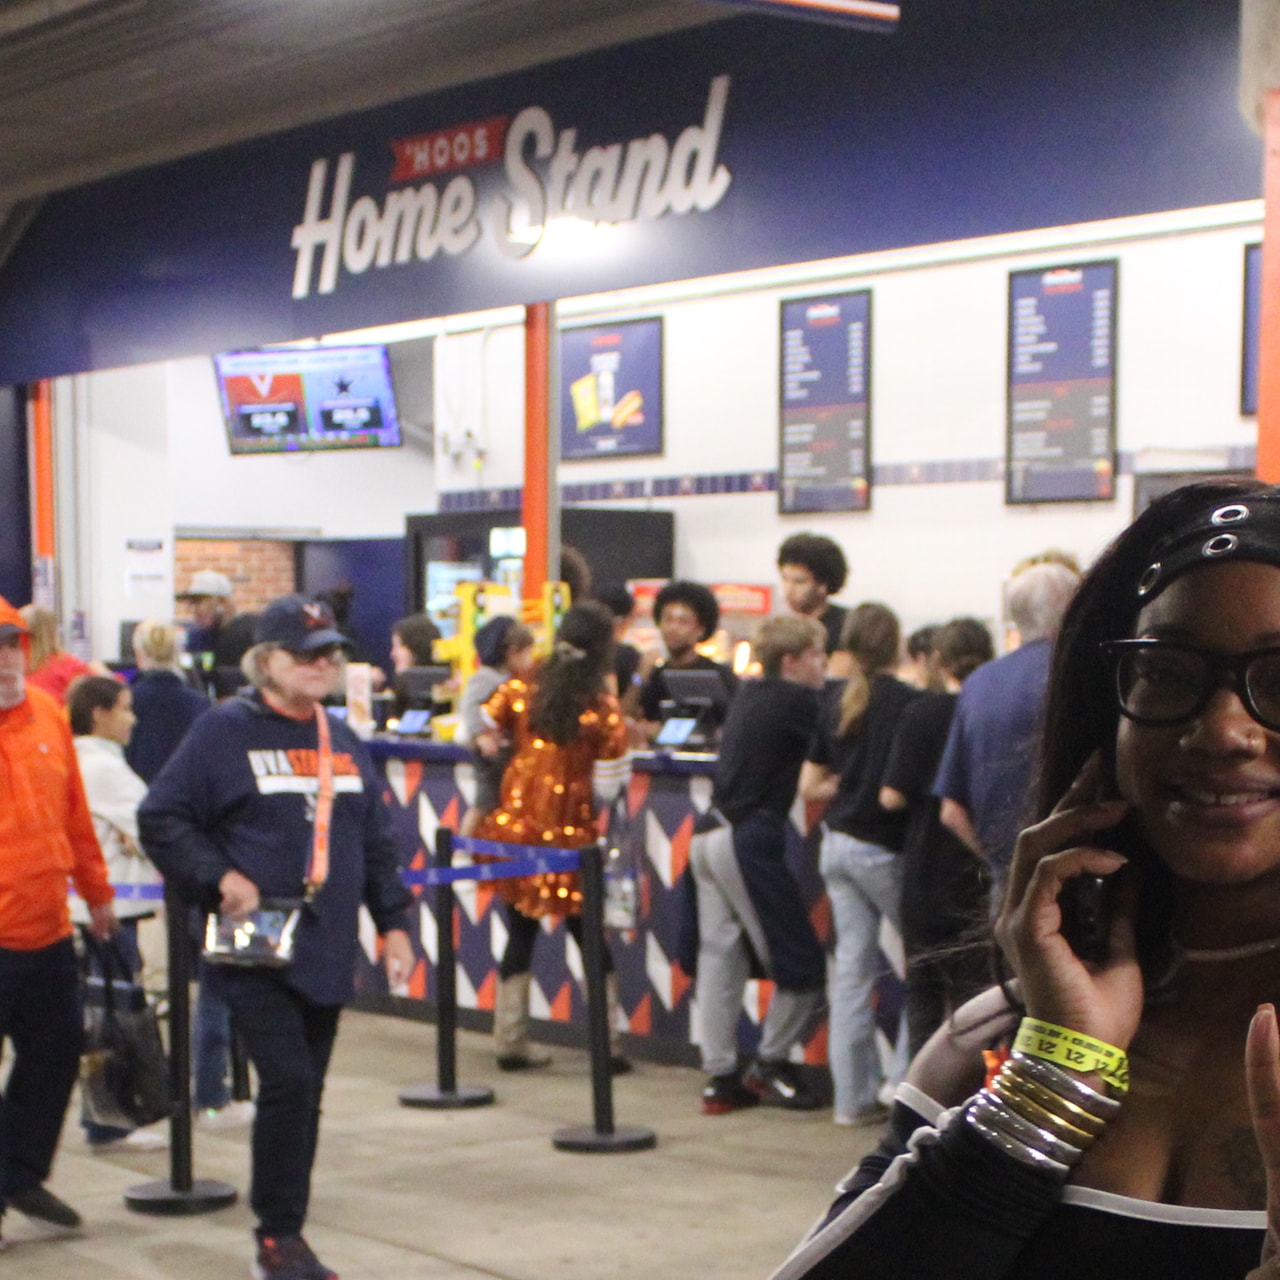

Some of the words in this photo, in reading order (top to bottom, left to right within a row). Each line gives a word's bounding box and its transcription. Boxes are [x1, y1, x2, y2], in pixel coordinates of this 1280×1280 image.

[291, 152, 483, 300] Home
[493, 74, 733, 261] Stand
[1066, 1048, 1086, 1064] 21
